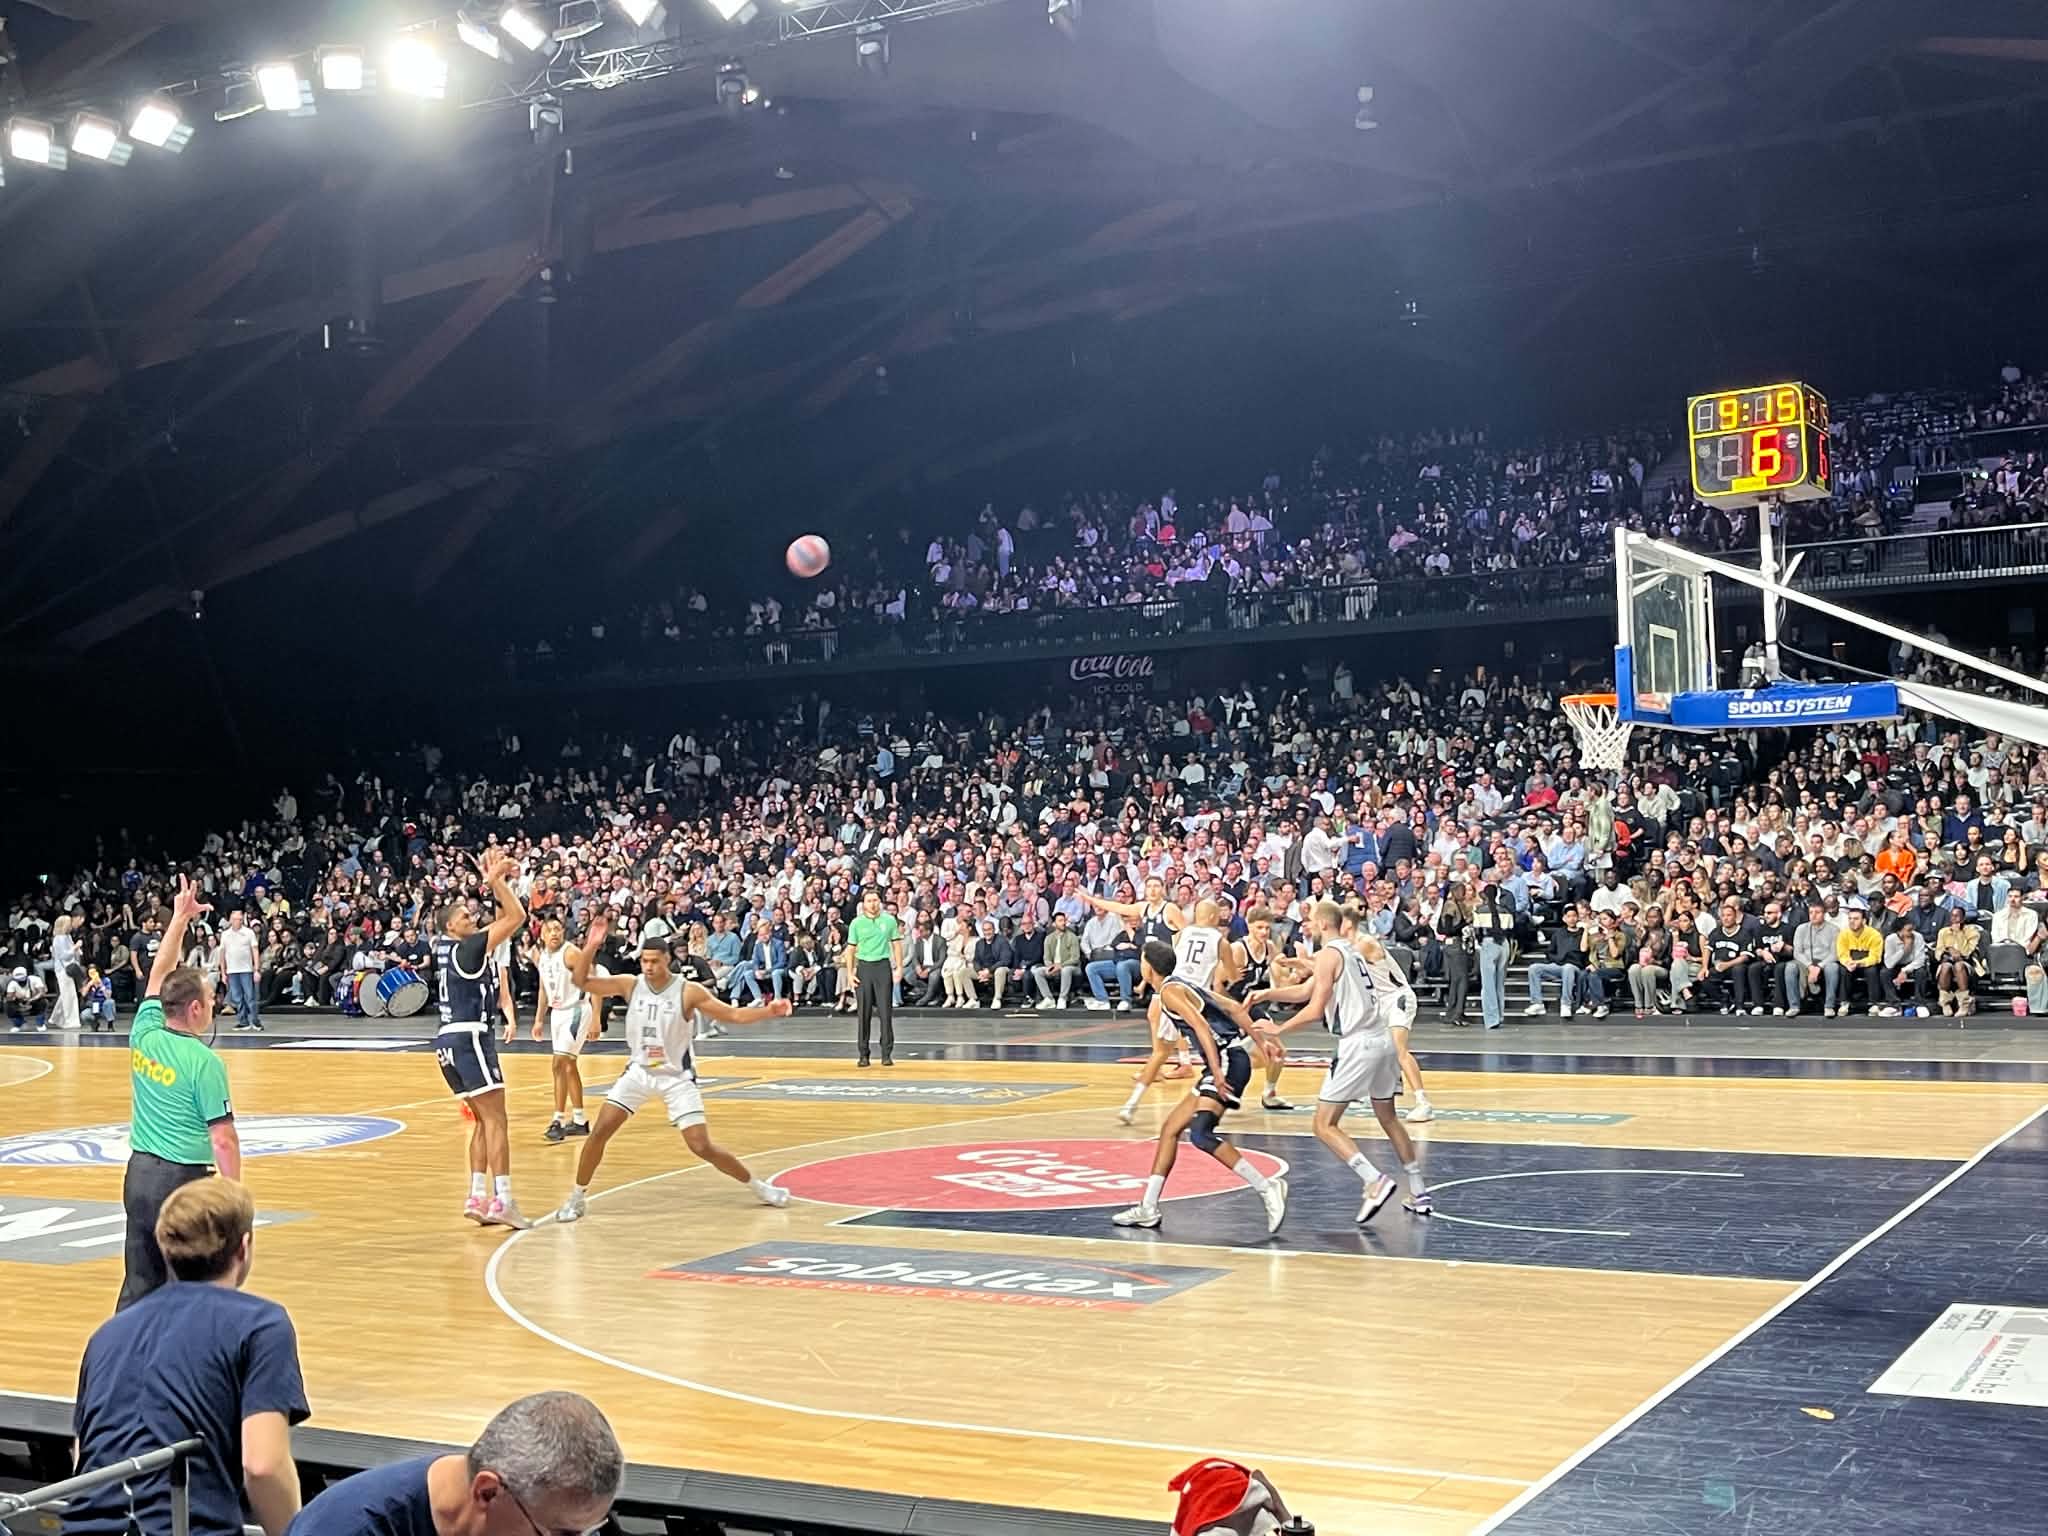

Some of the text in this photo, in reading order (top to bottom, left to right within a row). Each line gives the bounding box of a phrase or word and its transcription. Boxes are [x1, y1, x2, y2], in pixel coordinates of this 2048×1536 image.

[1718, 390, 1796, 430] 9:15
[1752, 429, 1781, 478] 6
[1114, 682, 1144, 693] COLD
[1185, 939, 1206, 965] 12
[1355, 957, 1375, 990] 9
[956, 1149, 1150, 1190] Circus
[735, 1257, 1172, 1300] Sobeltax
